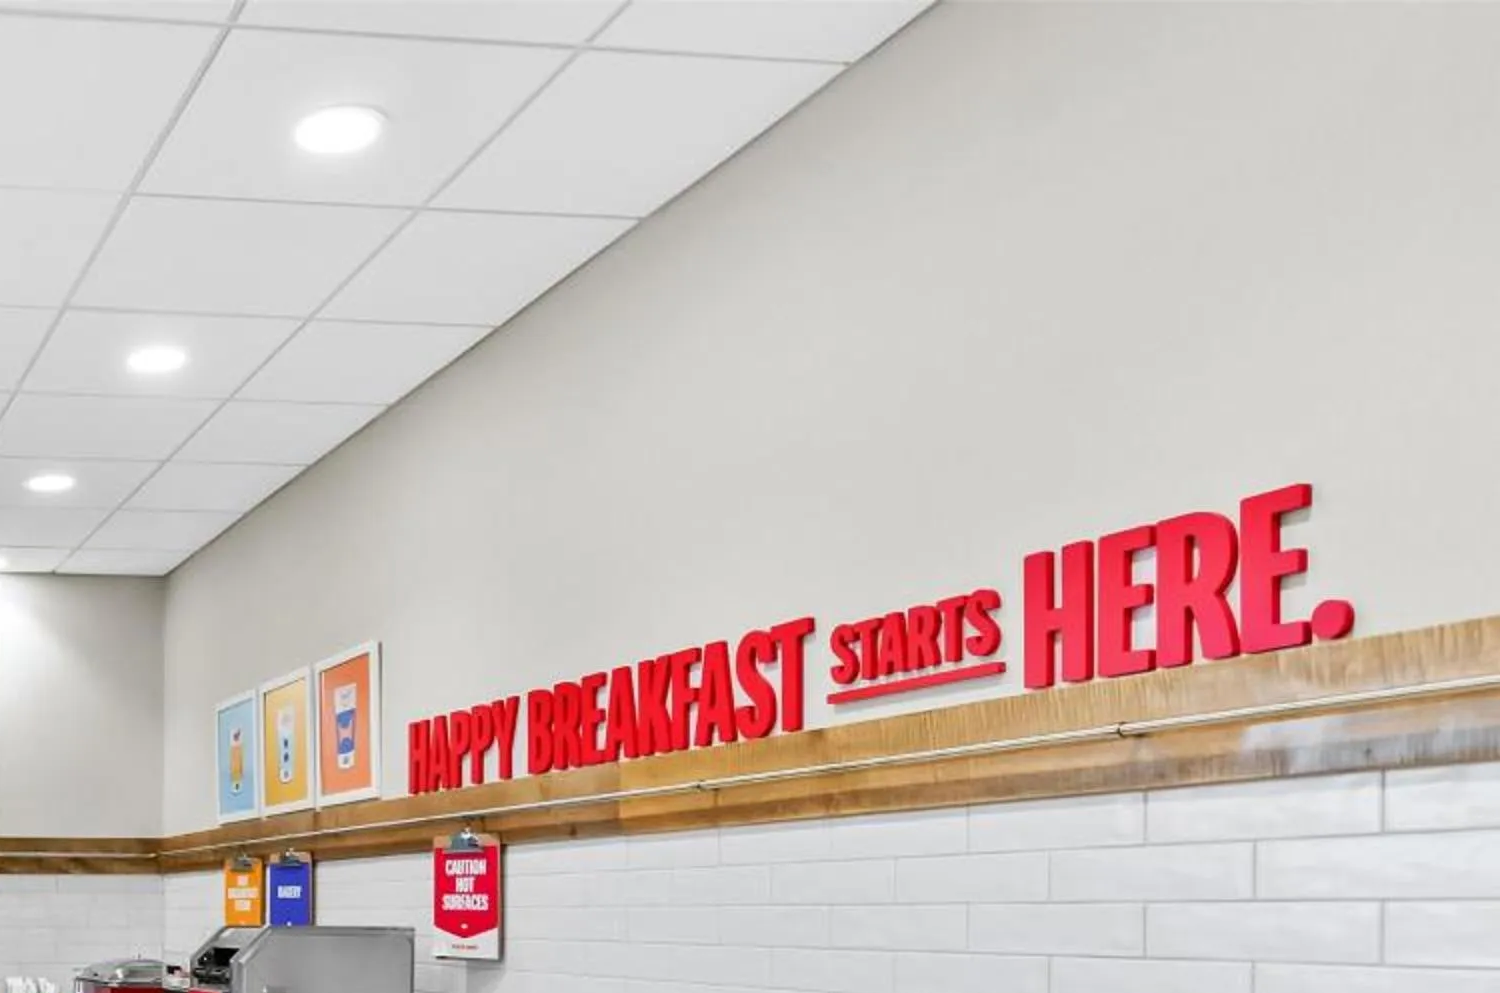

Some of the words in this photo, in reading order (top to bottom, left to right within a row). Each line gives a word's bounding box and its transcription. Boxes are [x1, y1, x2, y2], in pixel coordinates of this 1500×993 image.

[408, 695, 520, 795] HAPPY
[527, 617, 816, 776] BREAKFAST
[830, 589, 1001, 685] STARTS
[1023, 483, 1355, 690] HERE.
[445, 859, 488, 876] CAUTION
[455, 876, 475, 893] HOT
[441, 893, 489, 911] SURFACES
